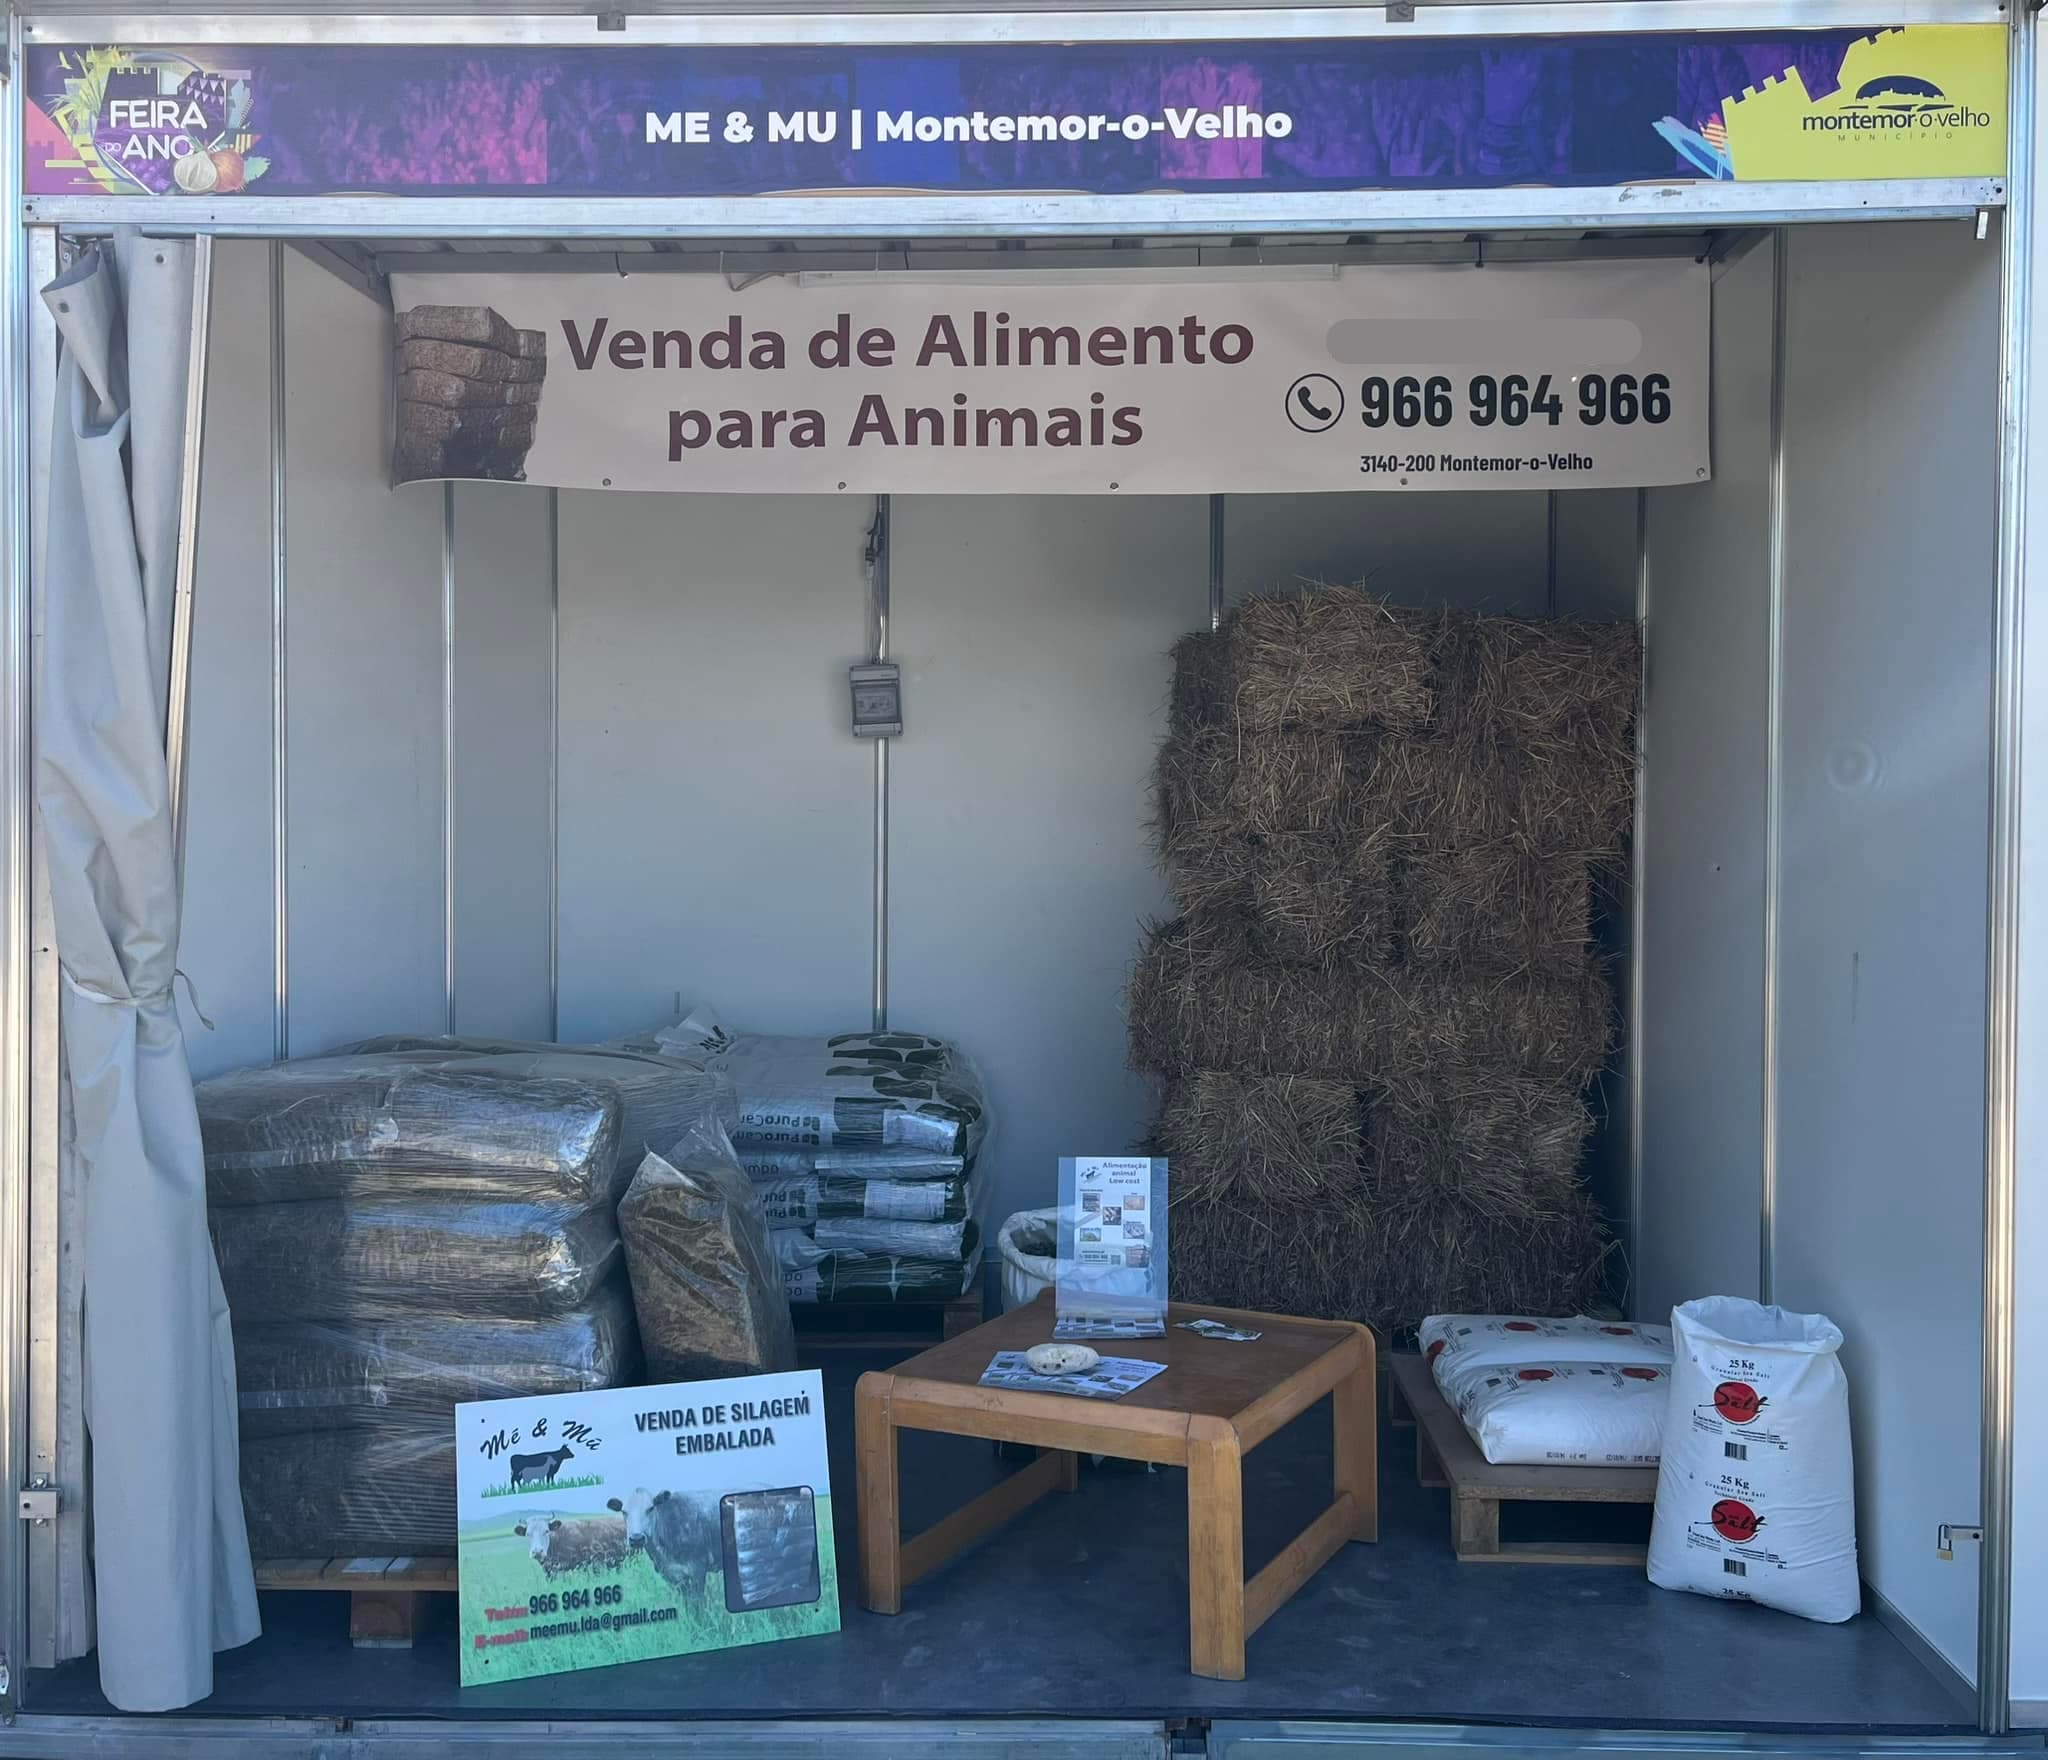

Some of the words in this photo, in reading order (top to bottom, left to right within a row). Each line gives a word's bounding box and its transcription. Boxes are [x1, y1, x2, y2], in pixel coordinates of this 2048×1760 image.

[110, 99, 208, 129] FEIRA
[645, 112, 711, 144] ME
[722, 110, 755, 144] &
[768, 110, 838, 144] MU
[876, 104, 1294, 144] Montemor-o-Velho
[103, 142, 122, 152] DO
[122, 134, 195, 161] ANO
[560, 314, 788, 371] Venda
[808, 312, 896, 369] de
[916, 310, 1255, 368] Alimento
[1360, 375, 1453, 428] 966
[1468, 373, 1563, 426] 964
[1577, 372, 1672, 426] 966
[667, 402, 827, 463] para
[848, 392, 1144, 449] Animais
[1359, 453, 1436, 473] 3140-200
[1440, 452, 1594, 473] Montemor-o-Velho
[1728, 1359, 1740, 1368] 25
[1741, 1359, 1756, 1371] Kg
[531, 1417, 548, 1438] &
[634, 1407, 697, 1432] VENDA
[702, 1405, 726, 1426] DE
[731, 1395, 811, 1422] SILAGEM
[675, 1426, 776, 1456] EMBALADA
[1720, 1474, 1732, 1485] 25
[1734, 1477, 1750, 1490] Kg
[529, 1592, 558, 1615] 966
[561, 1588, 590, 1611] 964
[593, 1584, 622, 1607] 966
[530, 1606, 678, 1641] meemu.lda@gmail.com
